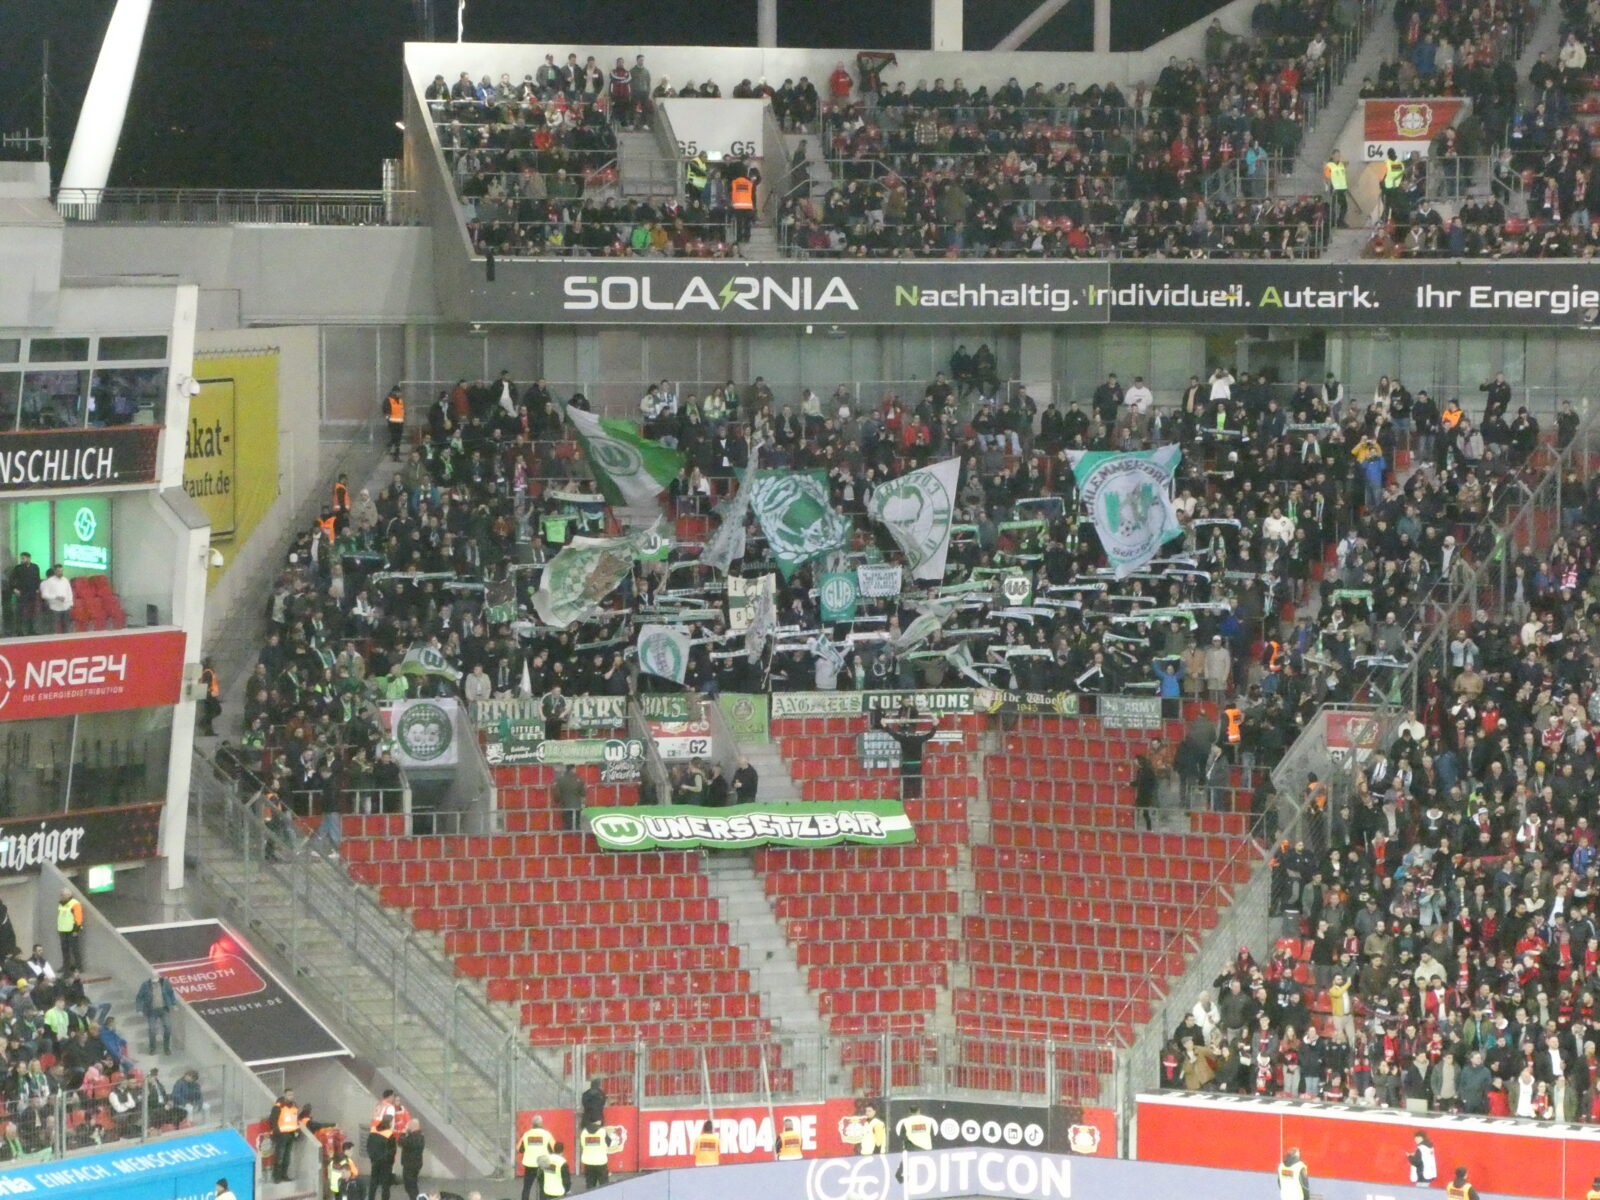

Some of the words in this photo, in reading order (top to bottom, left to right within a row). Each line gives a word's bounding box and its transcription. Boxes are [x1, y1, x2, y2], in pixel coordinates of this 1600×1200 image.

[730, 141, 756, 156] G5
[1367, 145, 1383, 157] G4
[563, 276, 859, 311] SOLARNIA
[895, 284, 1078, 311] Nachhaltig.
[1088, 283, 1251, 307] Individuell.
[1259, 285, 1379, 308] Autark.
[1417, 284, 1461, 308] Ihr
[1470, 284, 1599, 314] Energie
[24, 653, 127, 689] NRG24
[689, 740, 707, 754] G2
[642, 810, 885, 840] UNERSETZBAR
[35, 1164, 117, 1188] EINFACH.
[111, 1142, 228, 1174] MENSCHLICH.
[908, 1150, 1071, 1198] DITCON
